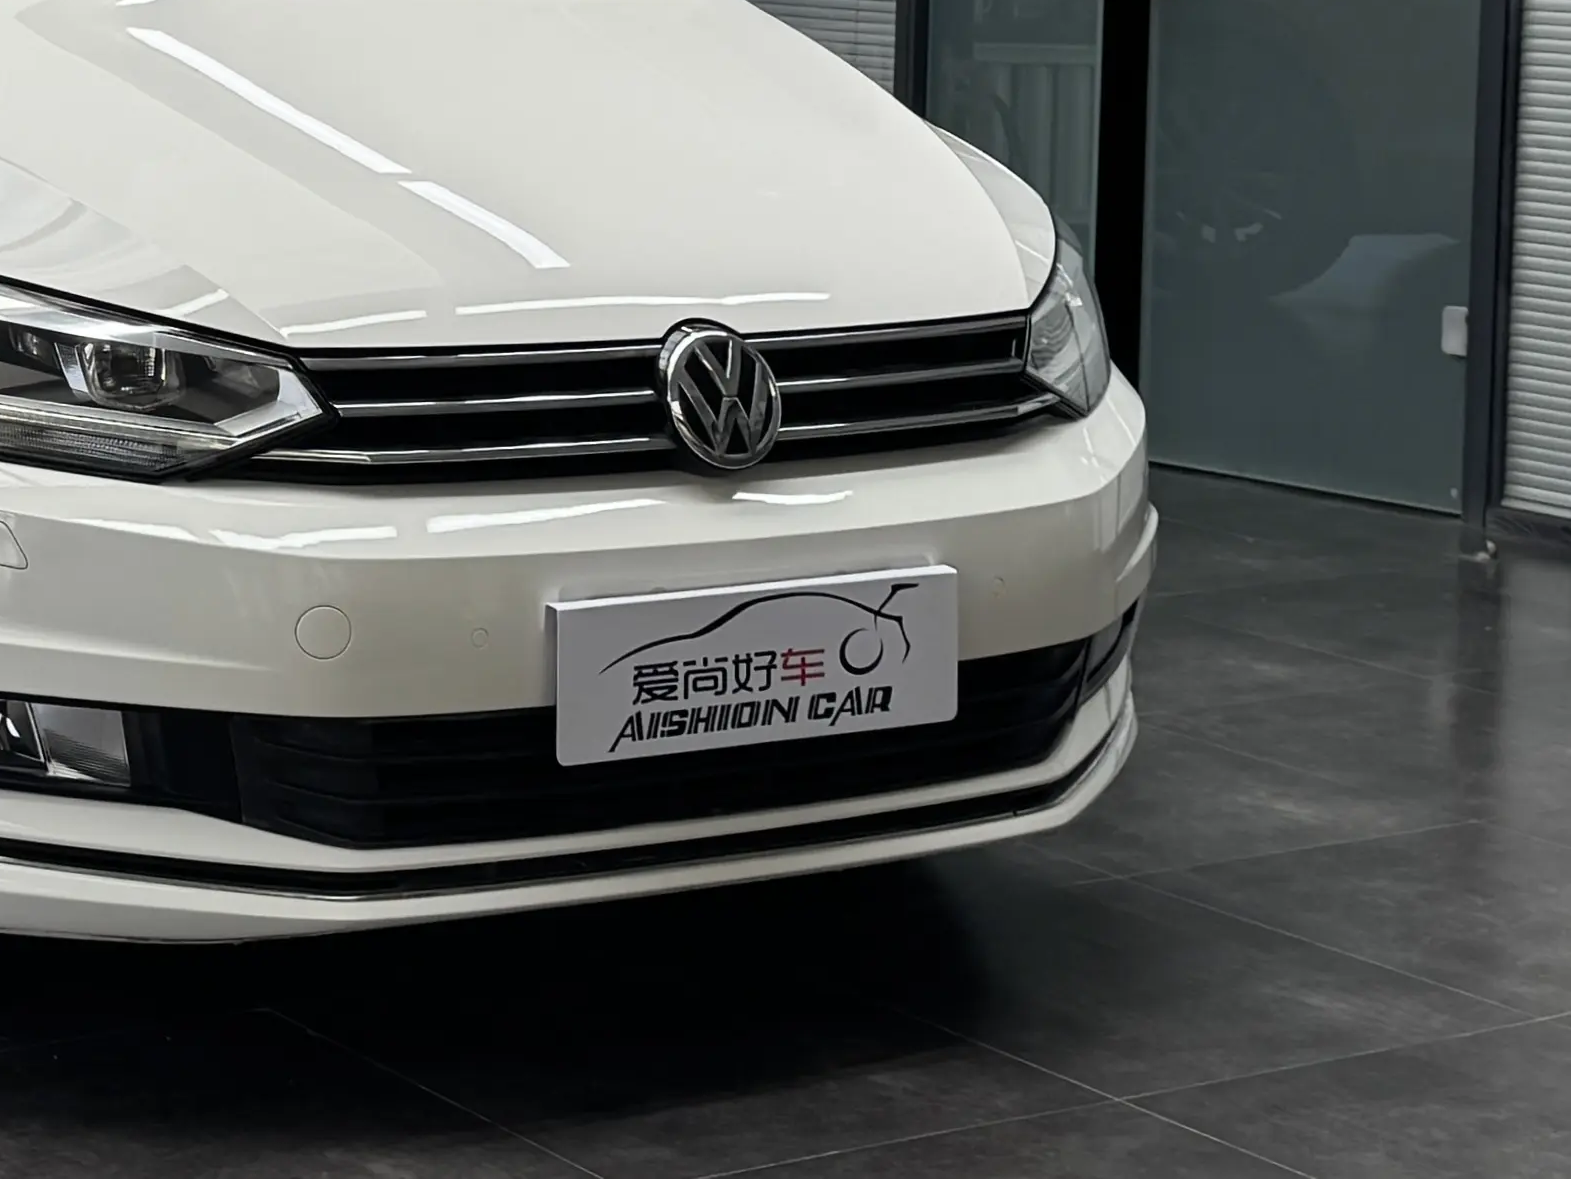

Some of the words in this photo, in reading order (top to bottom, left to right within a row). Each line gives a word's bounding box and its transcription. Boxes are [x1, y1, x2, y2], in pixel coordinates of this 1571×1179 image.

[632, 648, 825, 706] 爱尚好车
[807, 686, 893, 727] CAR
